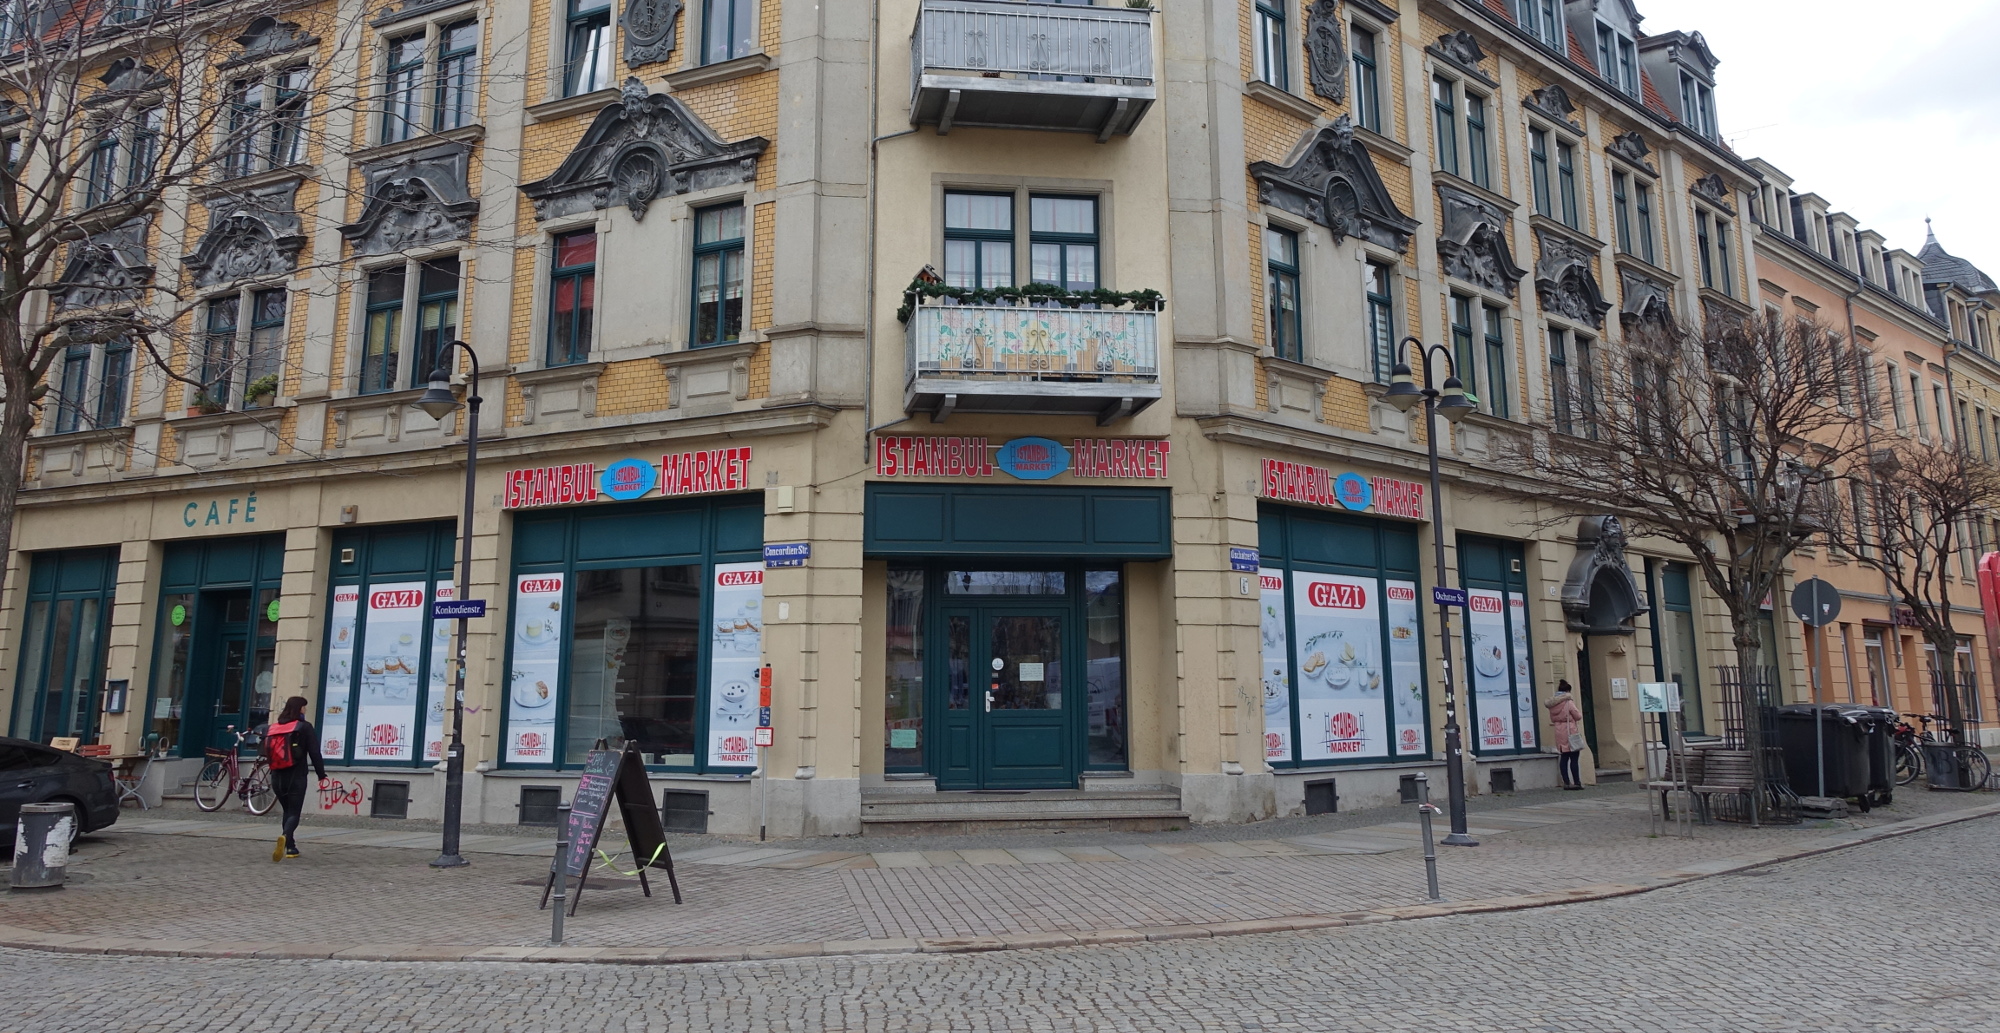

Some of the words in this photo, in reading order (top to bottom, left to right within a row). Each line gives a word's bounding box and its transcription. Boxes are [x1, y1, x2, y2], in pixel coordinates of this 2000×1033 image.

[875, 436, 994, 477] ISTANBUL
[1073, 438, 1171, 479] MARKET
[1015, 463, 1051, 471] MARKET
[504, 462, 598, 508] ISTANBUL
[660, 446, 752, 495] MARKET
[613, 483, 641, 492] MARKET
[1262, 458, 1335, 506] ISTANBUL
[1372, 476, 1424, 519] MARKET
[183, 490, 257, 528] CAFÉ
[435, 605, 482, 615] Konkordienstr.
[1330, 711, 1359, 738] ISTANBUL
[371, 724, 398, 745] ISTANBUL
[1486, 737, 1505, 745] MARKET
[368, 747, 399, 756] MARKET
[723, 736, 748, 753] ISTANBUL
[1330, 741, 1360, 753] MARKET
